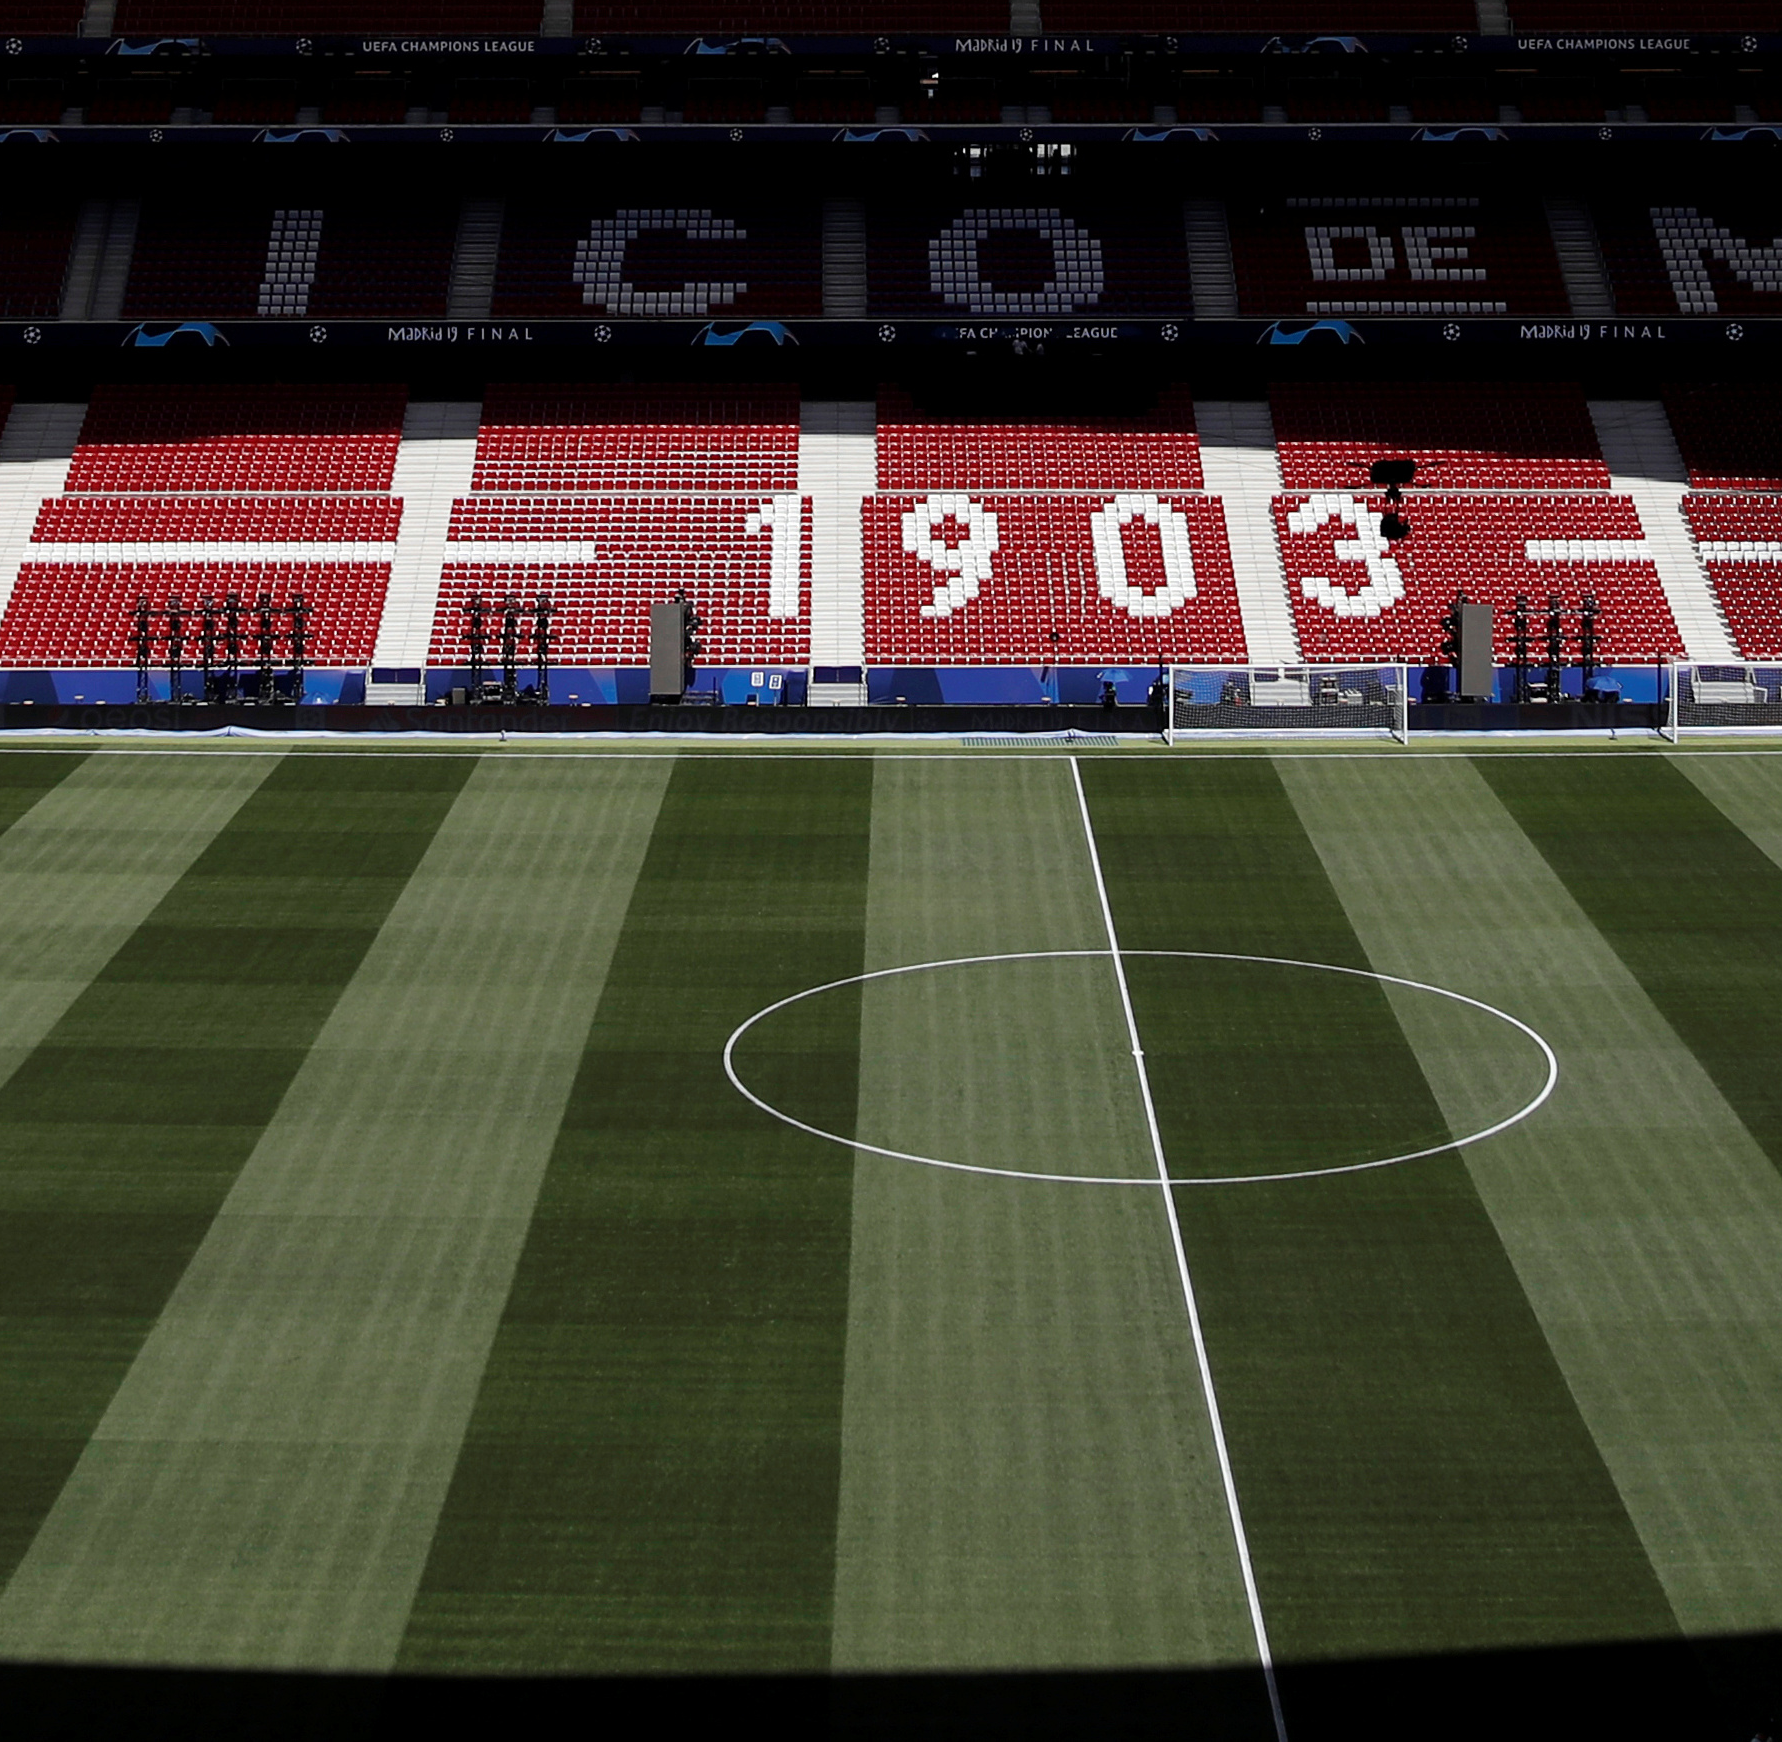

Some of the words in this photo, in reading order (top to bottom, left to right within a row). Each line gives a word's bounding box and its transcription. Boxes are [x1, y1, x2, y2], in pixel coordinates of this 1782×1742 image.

[362, 41, 398, 52] UEFA
[400, 40, 480, 52] CHAMPIONS
[484, 40, 535, 52] LEAGUE
[1011, 38, 1022, 54] 19
[1031, 39, 1094, 52] FINAL
[1517, 38, 1553, 50] UEFA
[1556, 38, 1635, 50] CHAMPIONS
[1639, 38, 1690, 50] LEAGUE
[447, 326, 458, 343] 19
[467, 327, 533, 341] FINAL
[1579, 324, 1591, 341] 19
[1600, 325, 1666, 339] FINAL
[745, 494, 1407, 618] 1903
